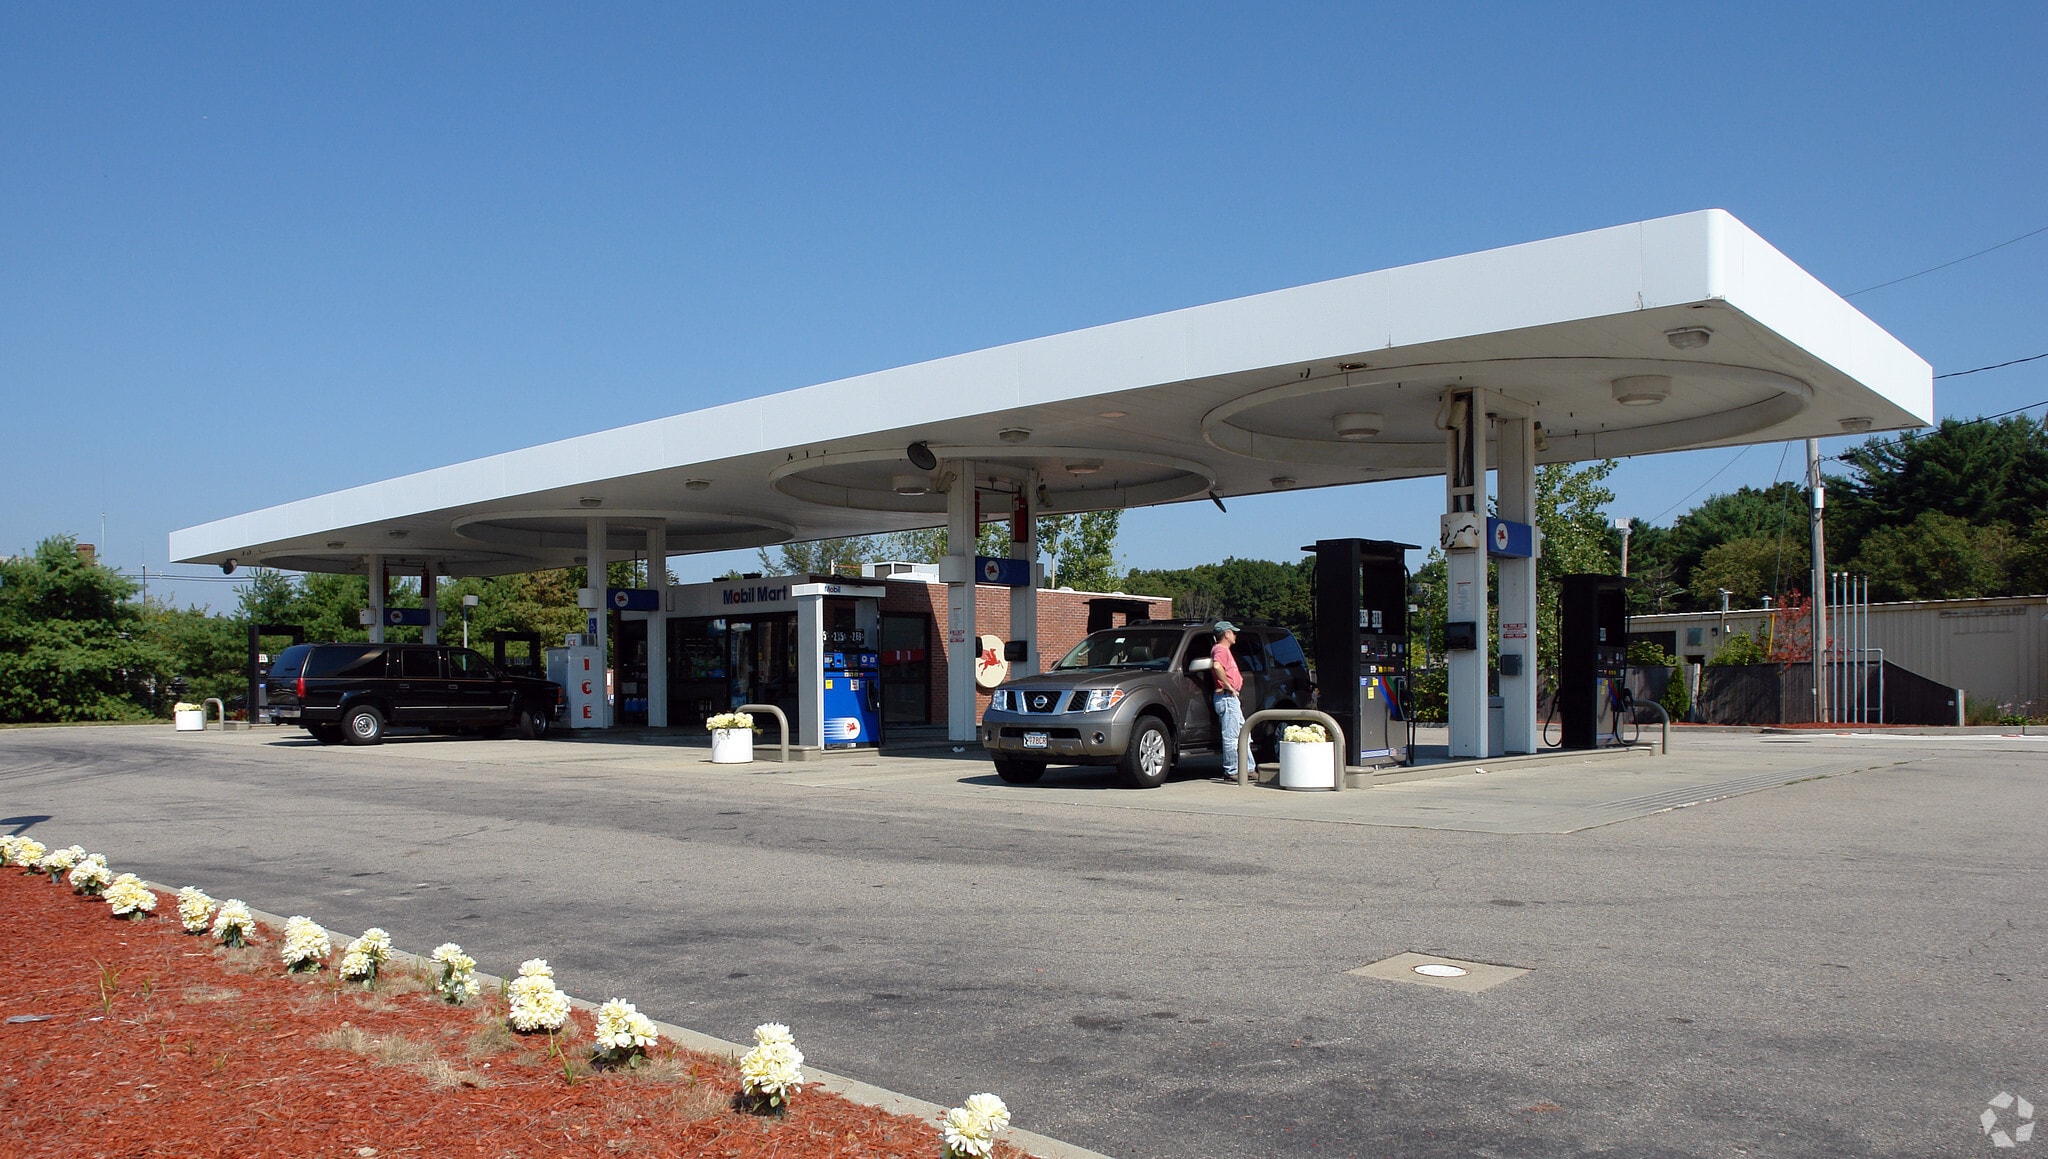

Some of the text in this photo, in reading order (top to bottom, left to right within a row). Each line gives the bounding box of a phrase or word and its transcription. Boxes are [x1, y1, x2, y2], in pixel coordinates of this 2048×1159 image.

[723, 585, 788, 605] Mobil Mart
[825, 585, 841, 593] Mobil
[581, 656, 592, 719] ICE
